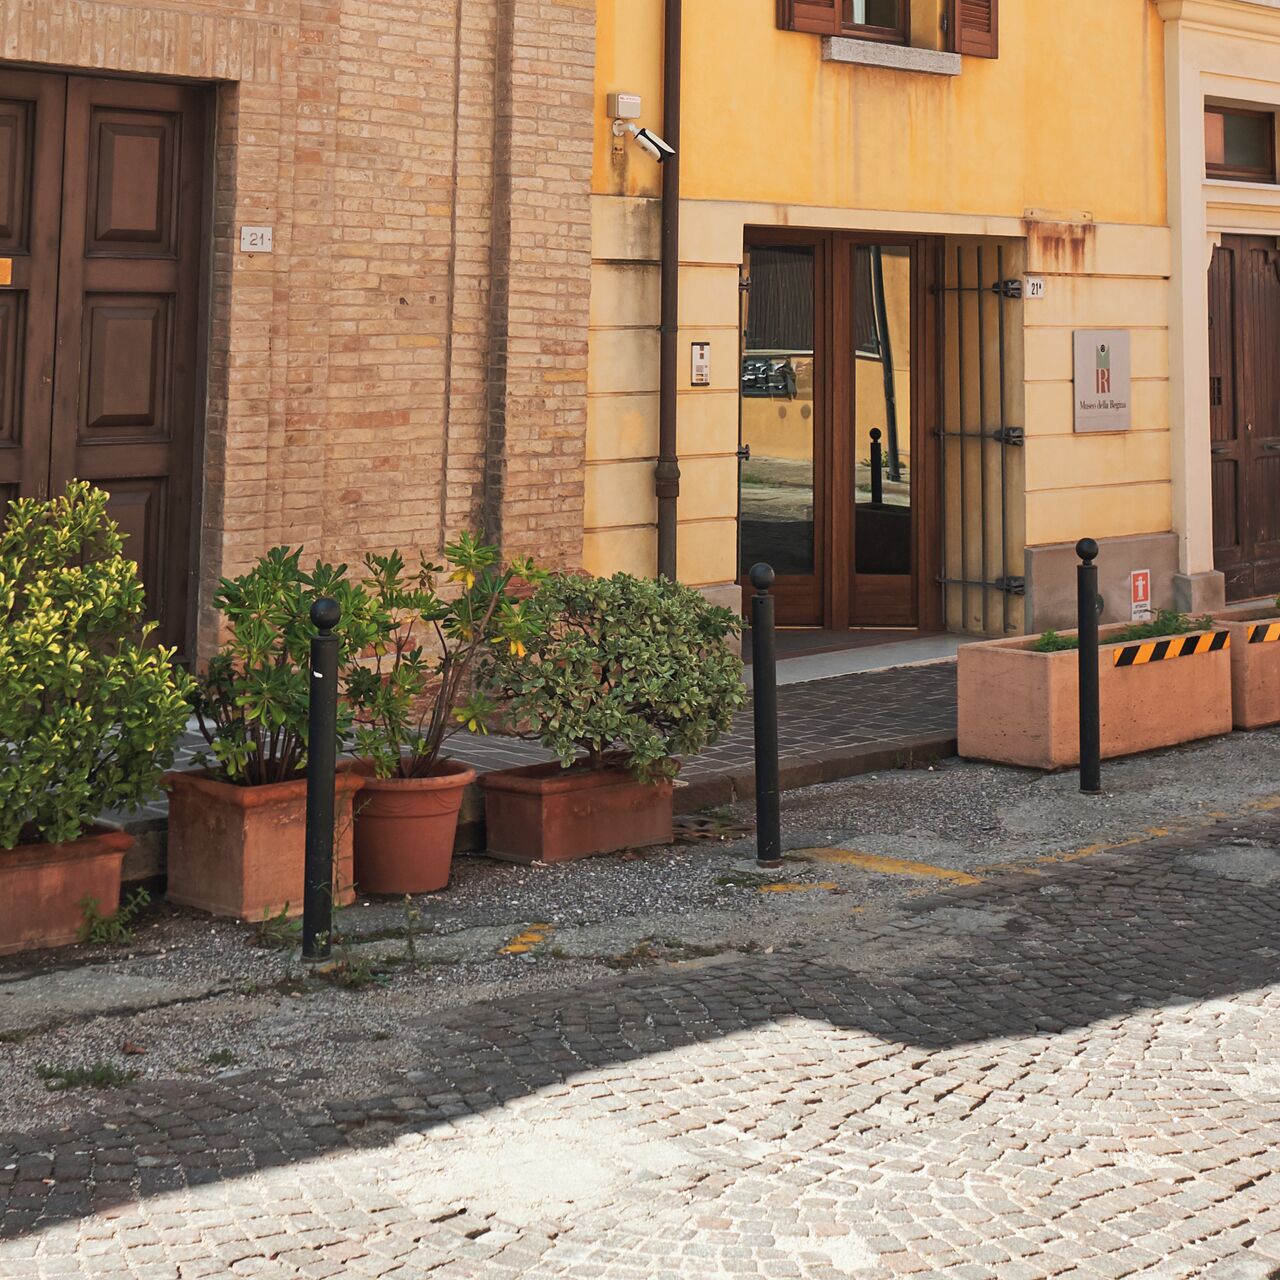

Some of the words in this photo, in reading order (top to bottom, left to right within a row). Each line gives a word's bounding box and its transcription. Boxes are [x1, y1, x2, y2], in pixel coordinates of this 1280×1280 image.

[249, 232, 264, 245] 21
[1080, 400, 1097, 409] Museo
[1097, 400, 1109, 409] della
